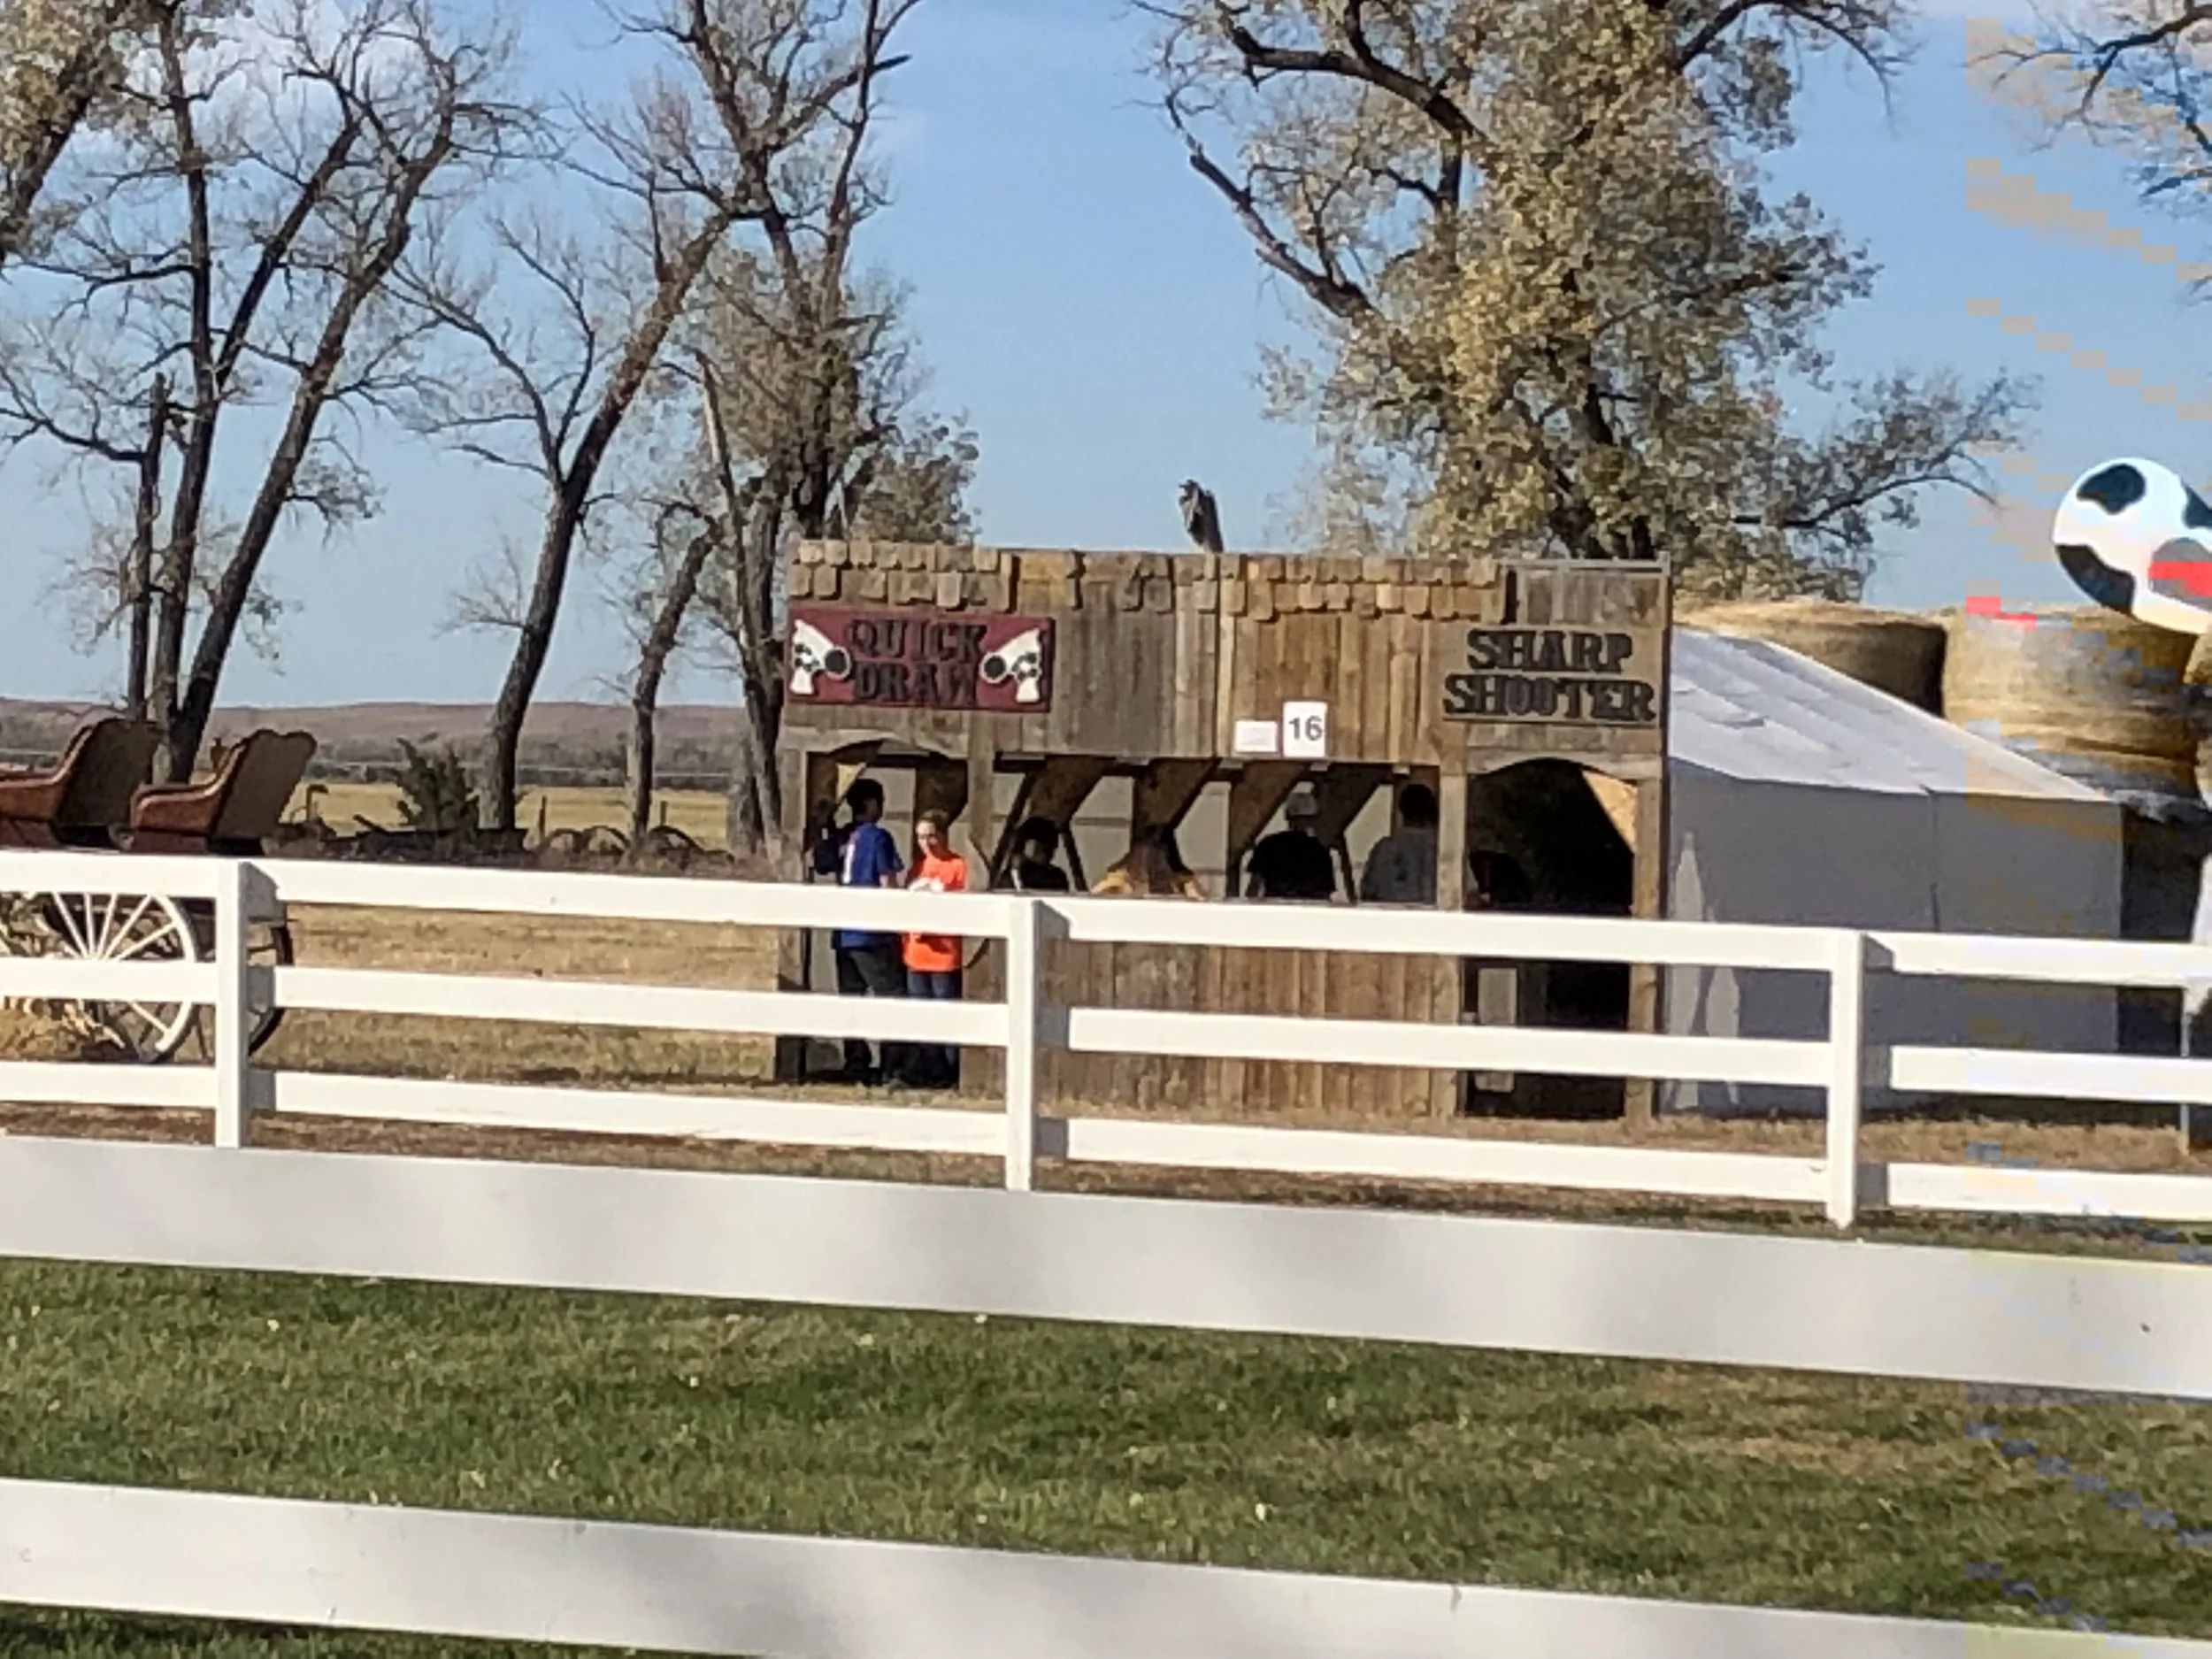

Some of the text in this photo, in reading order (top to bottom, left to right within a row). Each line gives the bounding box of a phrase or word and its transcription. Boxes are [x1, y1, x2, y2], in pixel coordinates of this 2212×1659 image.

[849, 619, 987, 662] QUICK
[1467, 629, 1632, 673] SHARP
[855, 664, 977, 703] DRAW
[1443, 673, 1657, 721] SHOOTER
[1288, 715, 1323, 741] 16
